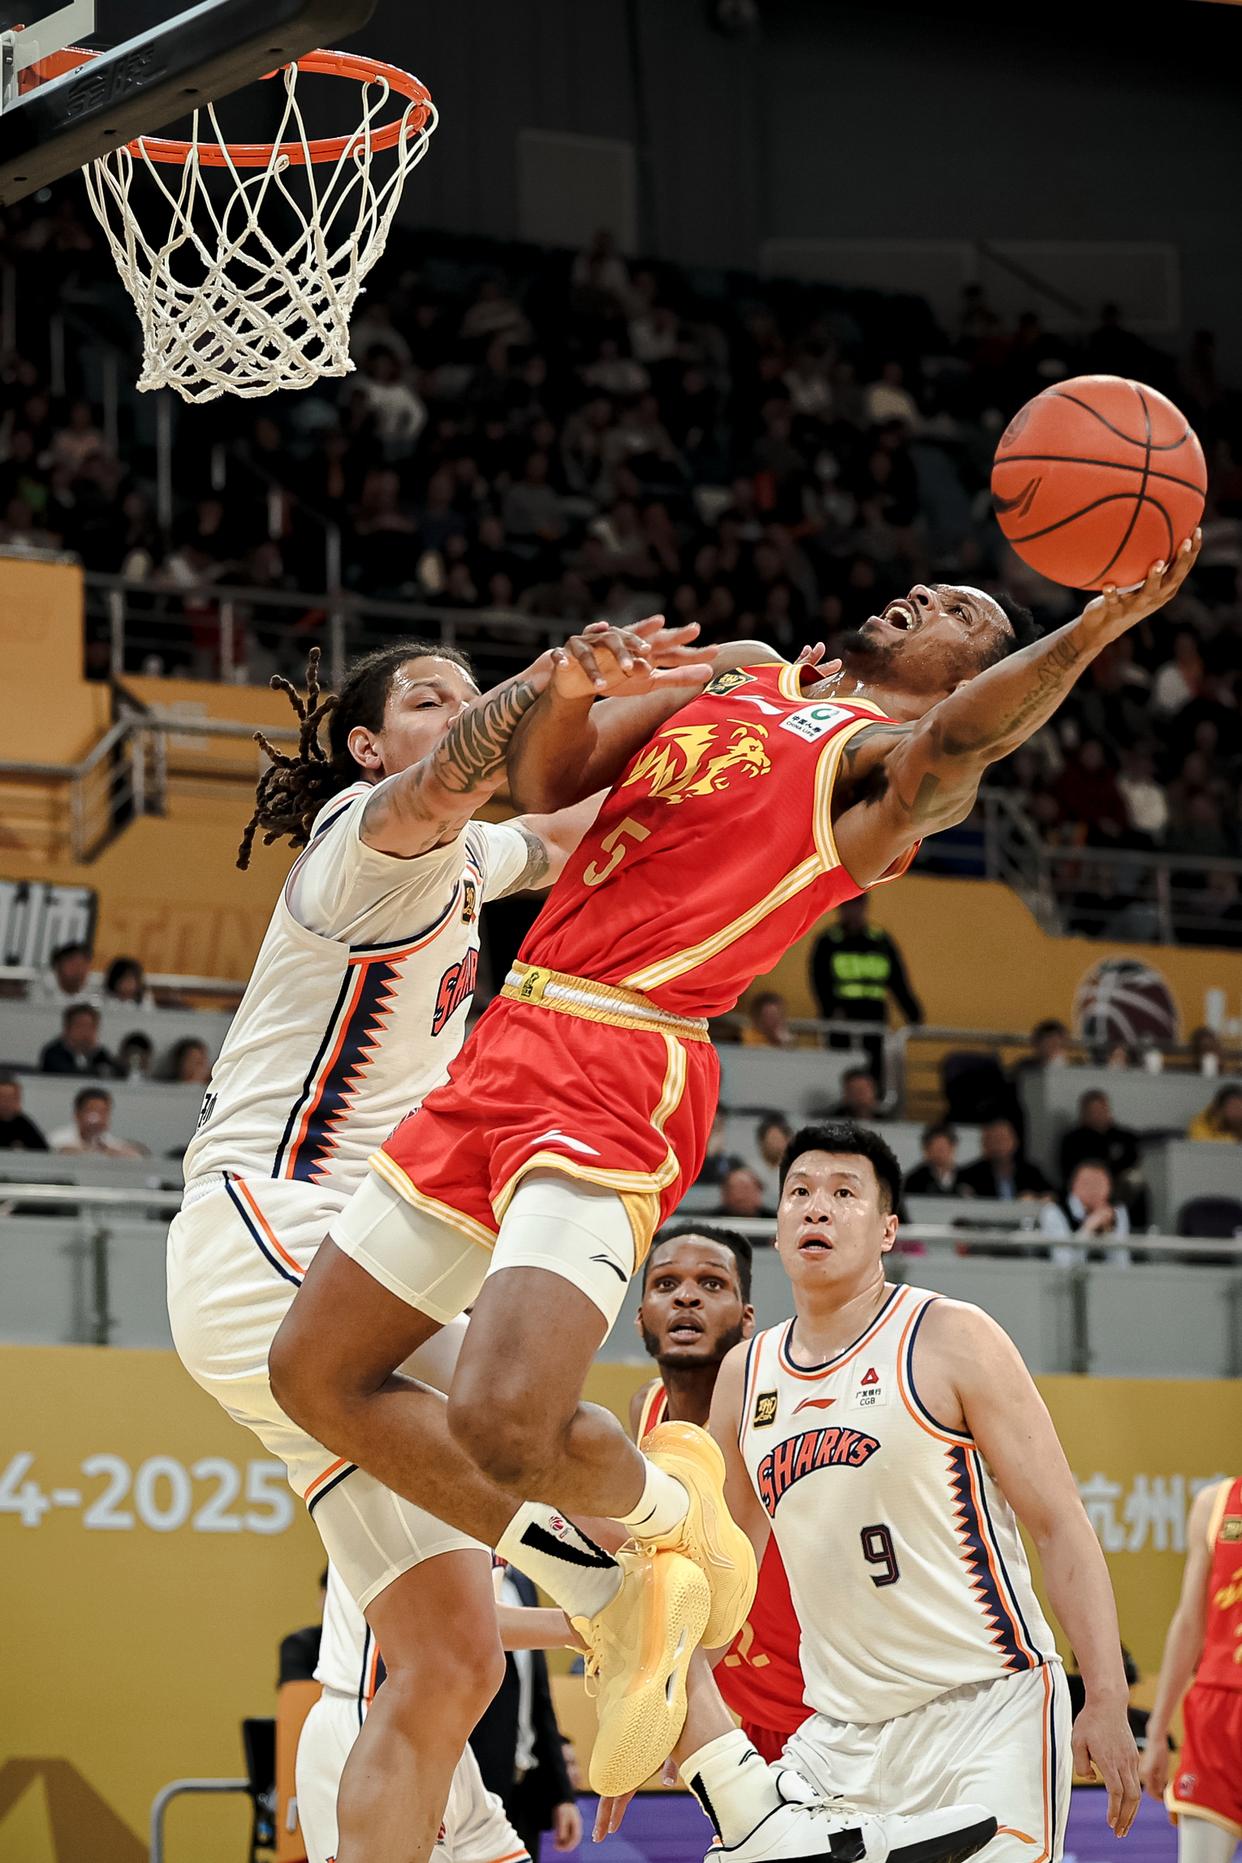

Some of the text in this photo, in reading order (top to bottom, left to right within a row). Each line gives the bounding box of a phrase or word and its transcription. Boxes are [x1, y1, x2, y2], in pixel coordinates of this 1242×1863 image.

[583, 816, 651, 887] 5
[860, 1397, 876, 1406] CGB
[0, 1451, 293, 1534] 4-2025
[757, 1427, 881, 1518] SHARKS
[860, 1524, 900, 1587] 9
